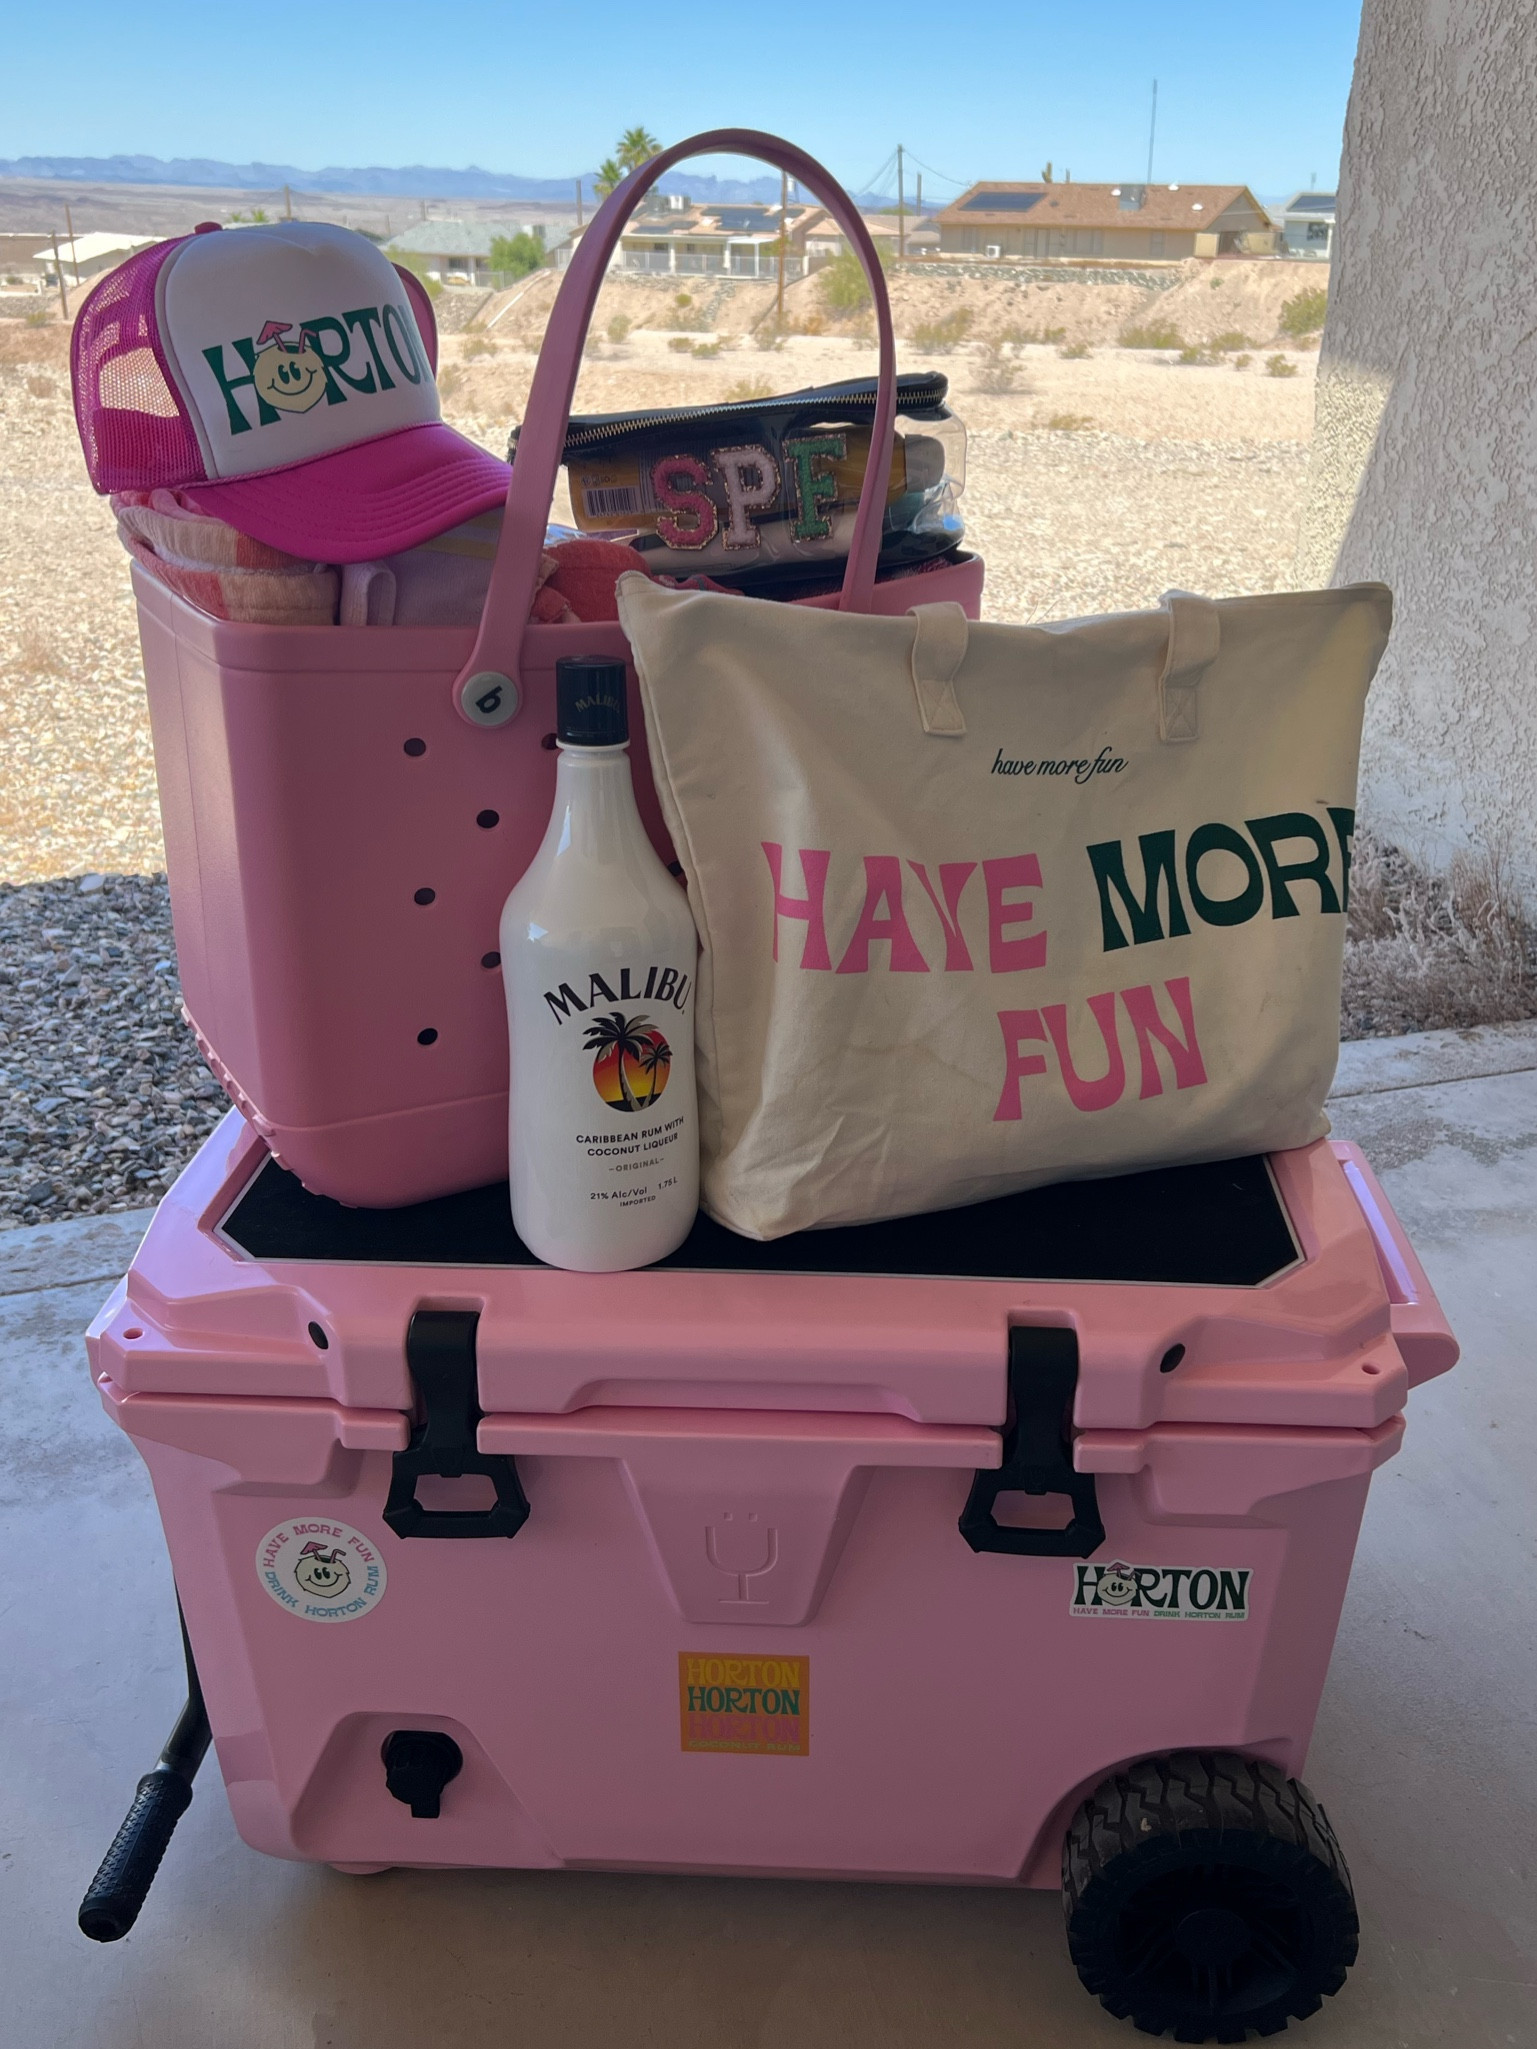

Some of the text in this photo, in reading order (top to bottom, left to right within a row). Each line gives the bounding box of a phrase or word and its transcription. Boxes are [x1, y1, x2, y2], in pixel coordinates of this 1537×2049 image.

[650, 433, 848, 552] SPF
[991, 746, 1129, 785] have more fun
[760, 842, 1048, 974] HAVE
[992, 976, 1208, 1122] FUN
[576, 1116, 685, 1144] CARIBBEAN RUM WITH
[587, 1132, 678, 1156] COCONUT LIQUEUR
[590, 1186, 648, 1200] 21% Alc/Vol
[657, 1179, 673, 1190] 1.75
[619, 1195, 656, 1207] IMPORTED
[263, 1523, 375, 1568] HAVE MORE FUN
[265, 1565, 378, 1618] DRINK HORTON RUM
[1073, 1607, 1098, 1615] HAVE
[1102, 1608, 1128, 1616] MORE
[687, 1658, 801, 1688] HORTON
[687, 1686, 801, 1716] HORTON
[688, 1714, 801, 1743] HORTON
